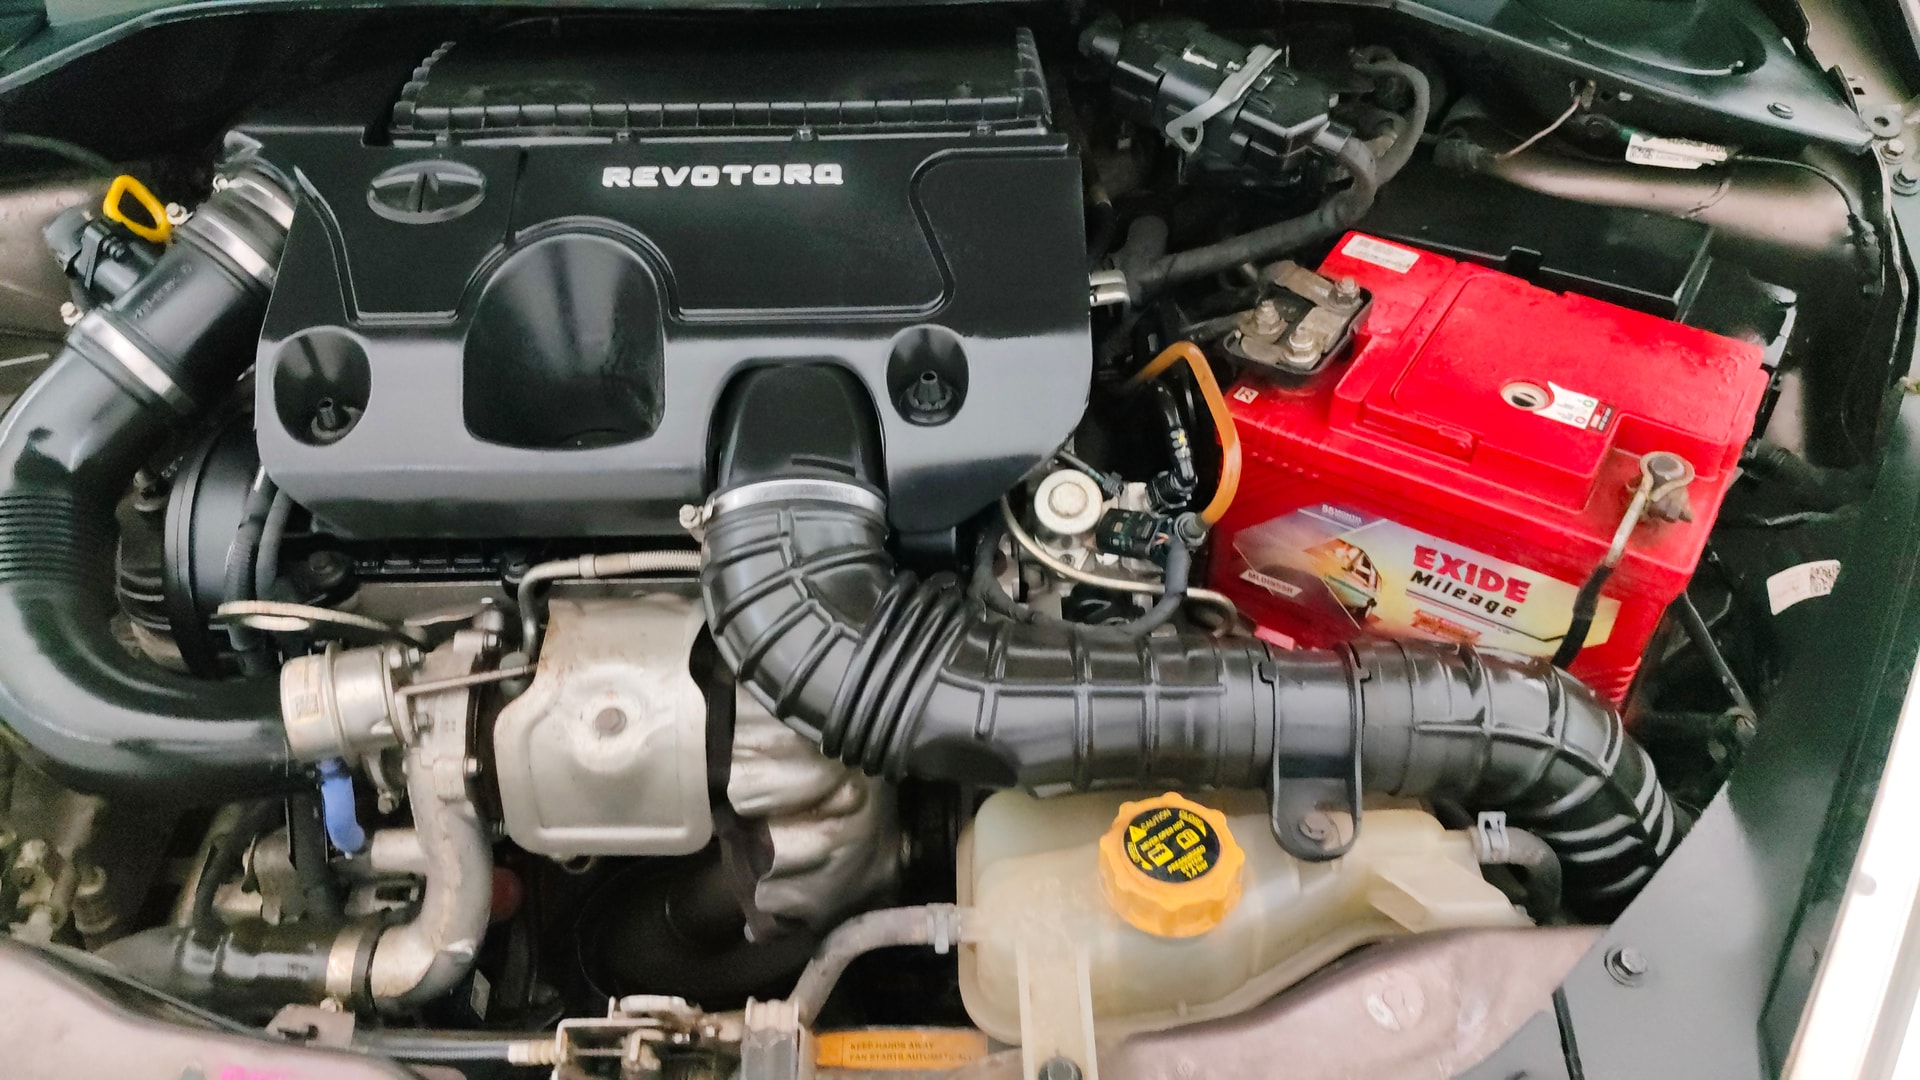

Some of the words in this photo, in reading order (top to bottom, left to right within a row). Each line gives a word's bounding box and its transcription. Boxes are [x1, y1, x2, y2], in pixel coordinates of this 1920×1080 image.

[602, 163, 843, 188] REVOTORQ
[1413, 544, 1532, 604] EXIDE
[1410, 570, 1518, 618] Mileage
[1141, 808, 1172, 831] CAUTION
[850, 1040, 873, 1051] KEEP
[875, 1040, 906, 1050] HANDS
[908, 1040, 934, 1050] AWAY
[850, 1053, 867, 1063] FAN
[869, 1053, 904, 1063] STARTS
